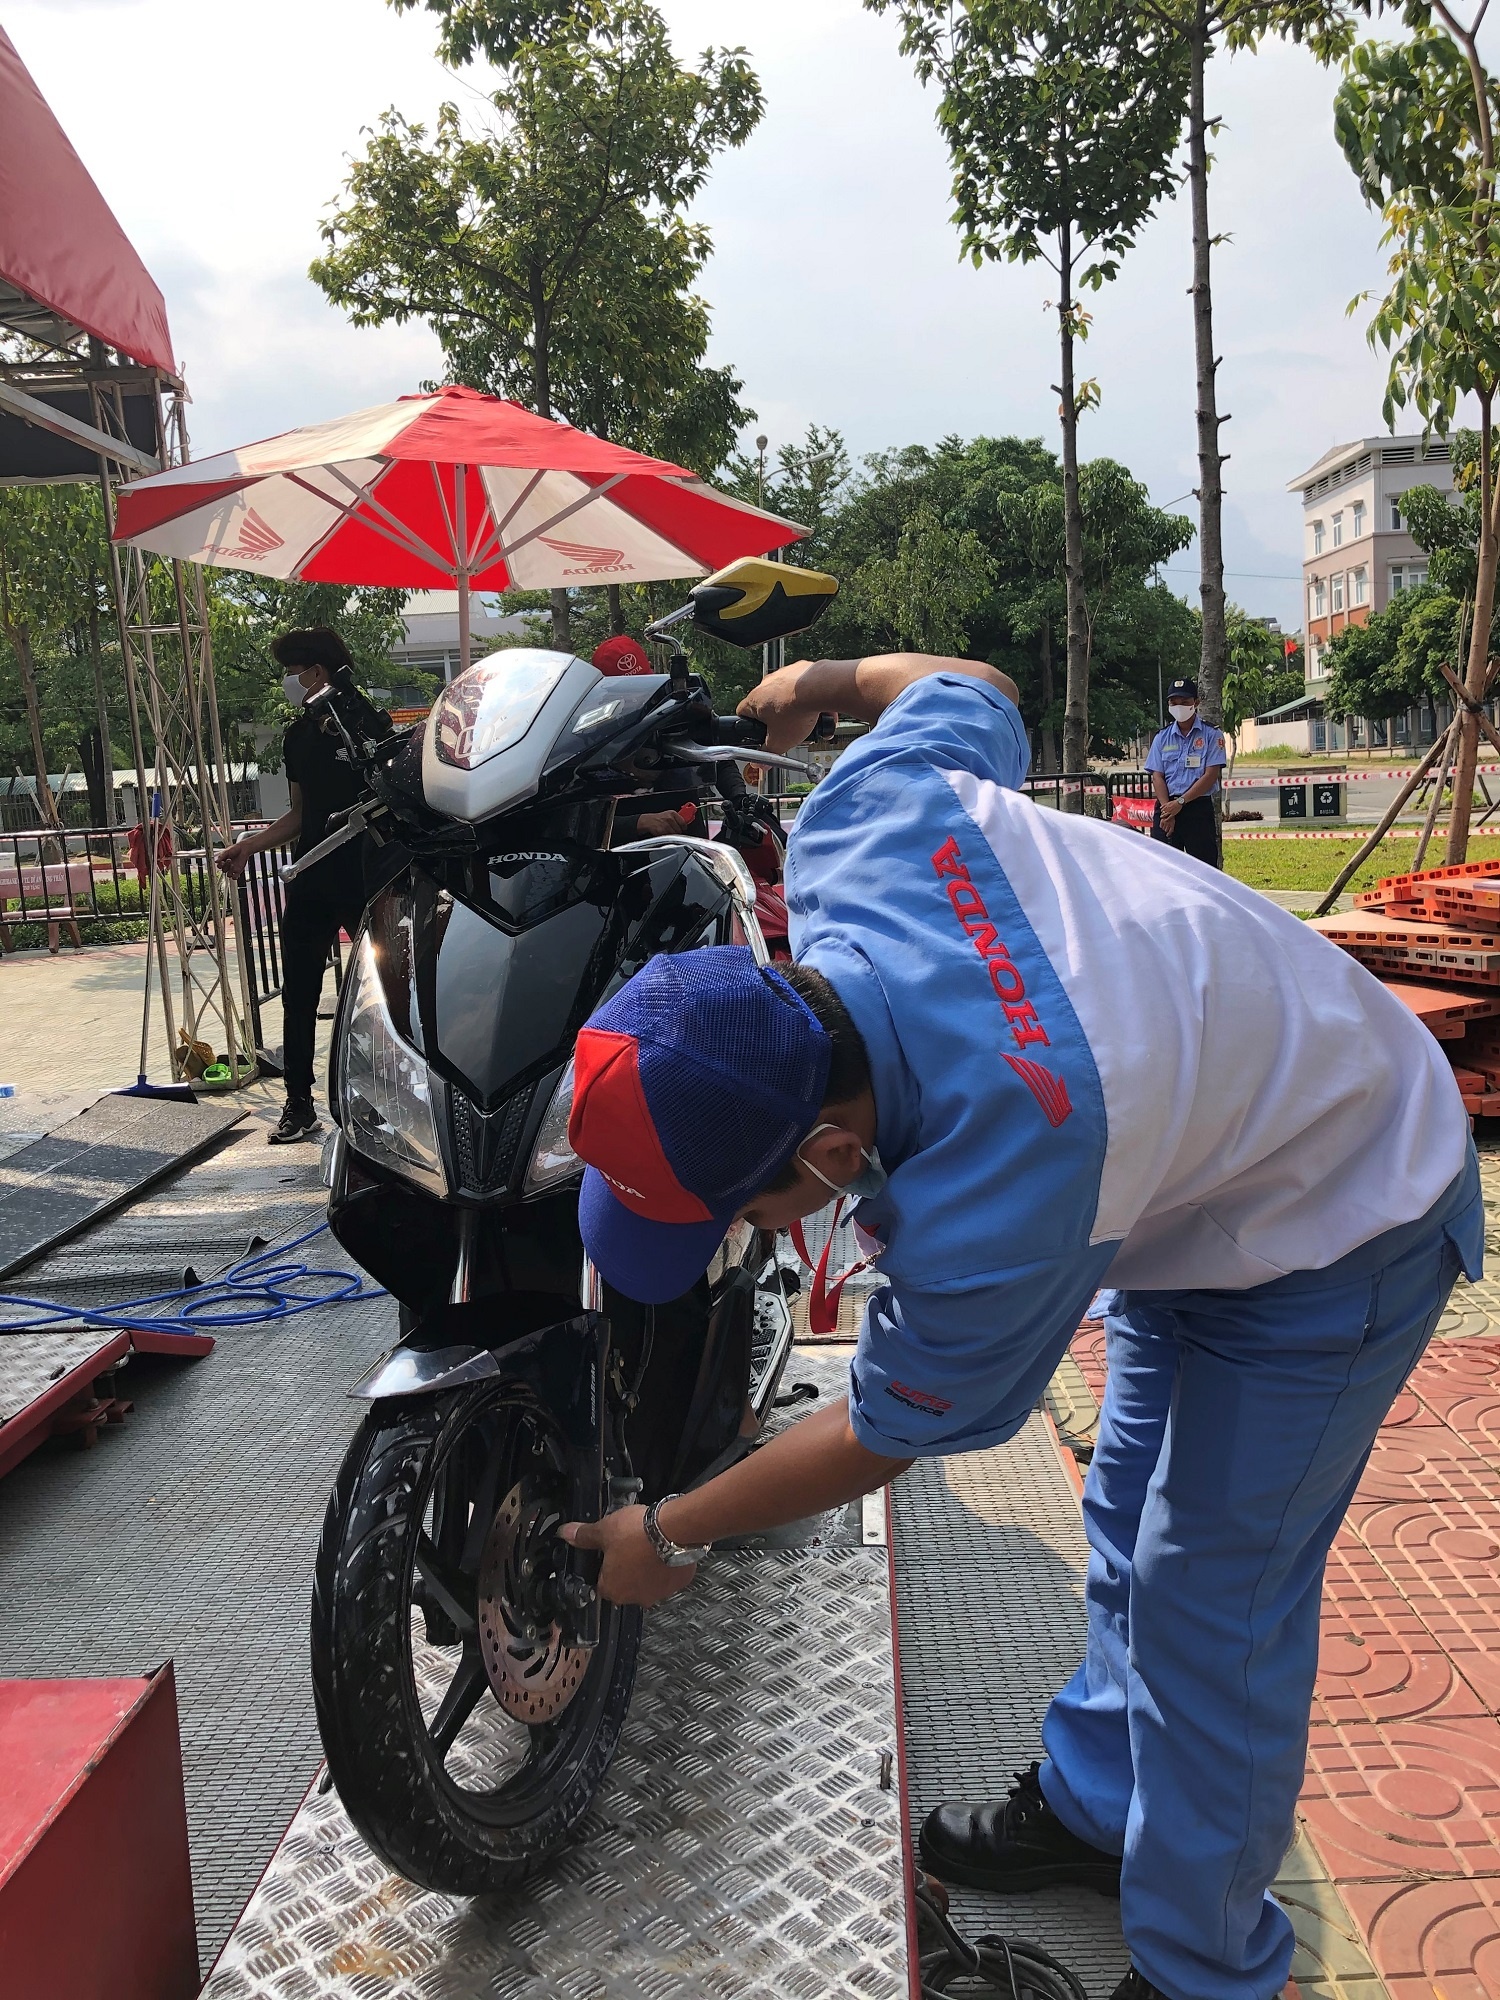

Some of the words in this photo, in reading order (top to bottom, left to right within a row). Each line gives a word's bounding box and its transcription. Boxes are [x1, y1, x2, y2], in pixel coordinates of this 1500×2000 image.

[622, 665, 643, 676] OYOTA
[486, 851, 569, 866] HONDA
[930, 835, 1051, 1050] HONDA
[884, 1386, 945, 1417] SERVICE
